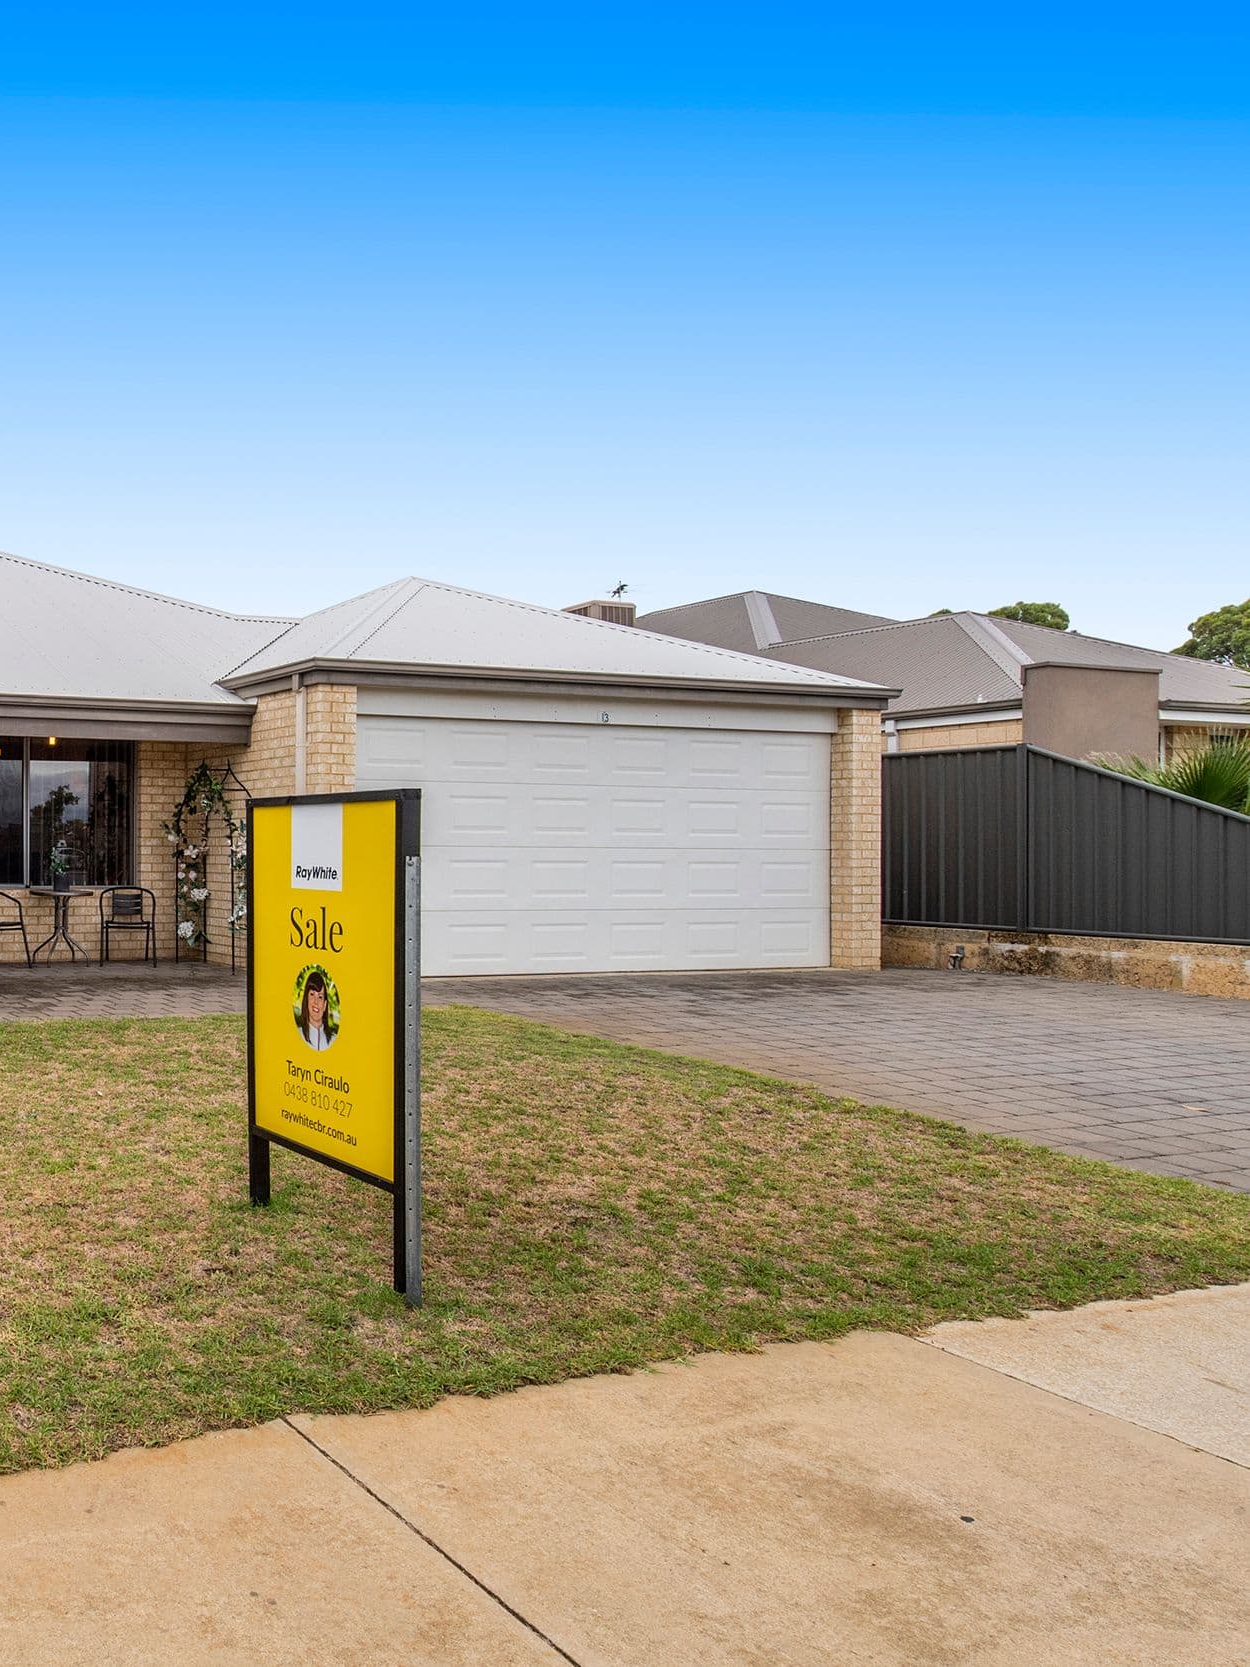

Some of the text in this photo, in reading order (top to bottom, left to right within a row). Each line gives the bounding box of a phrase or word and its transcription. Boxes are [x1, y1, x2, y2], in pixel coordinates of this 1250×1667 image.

[290, 906, 344, 953] Sale
[286, 1060, 350, 1094] Taryn Ciraulo
[283, 1081, 353, 1118] 0438 810 427
[281, 1109, 357, 1146] raywhitecbr.com.au
